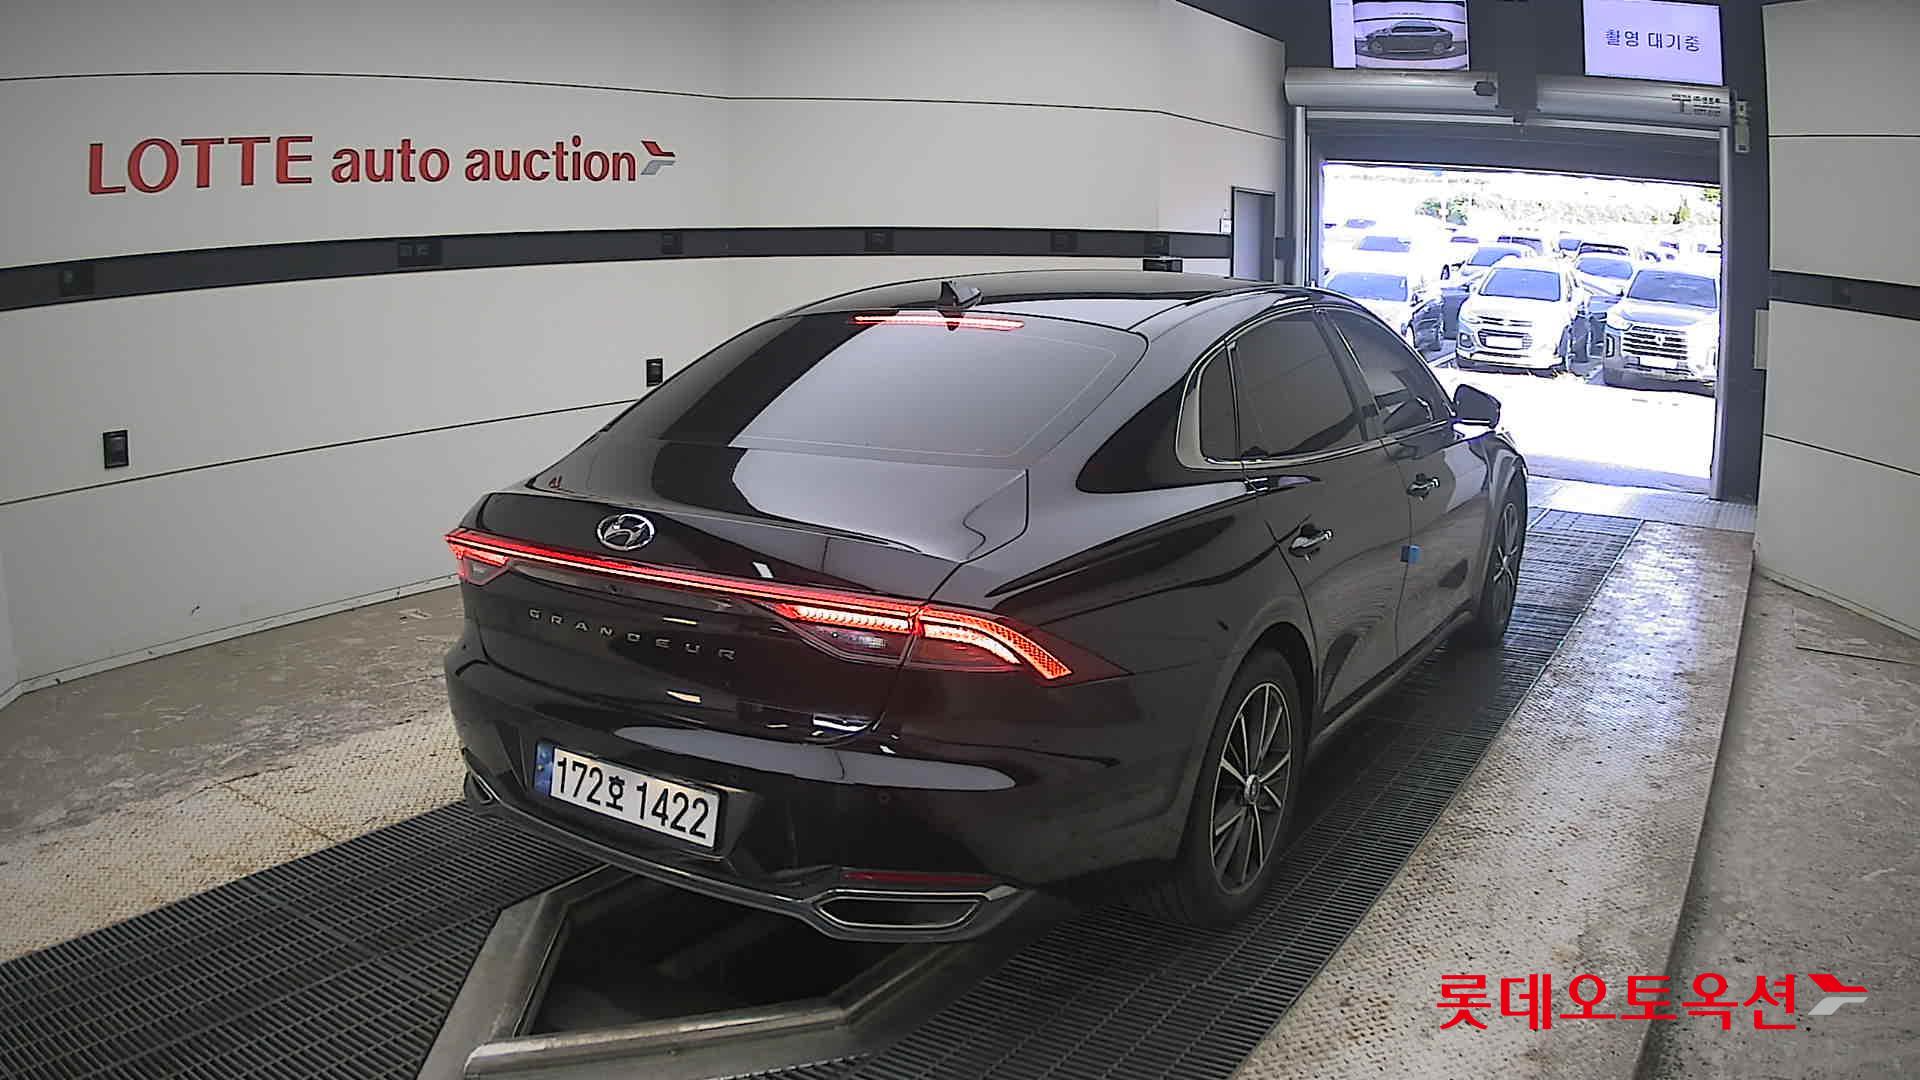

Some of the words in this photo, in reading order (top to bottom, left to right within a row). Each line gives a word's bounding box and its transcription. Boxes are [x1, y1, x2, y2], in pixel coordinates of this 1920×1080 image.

[1648, 32, 1700, 52] 대기중
[89, 136, 312, 195] LOTTE
[331, 139, 450, 183] auto
[465, 135, 637, 182] auction
[529, 608, 736, 661] GRANDEUR
[636, 782, 709, 838] 1422
